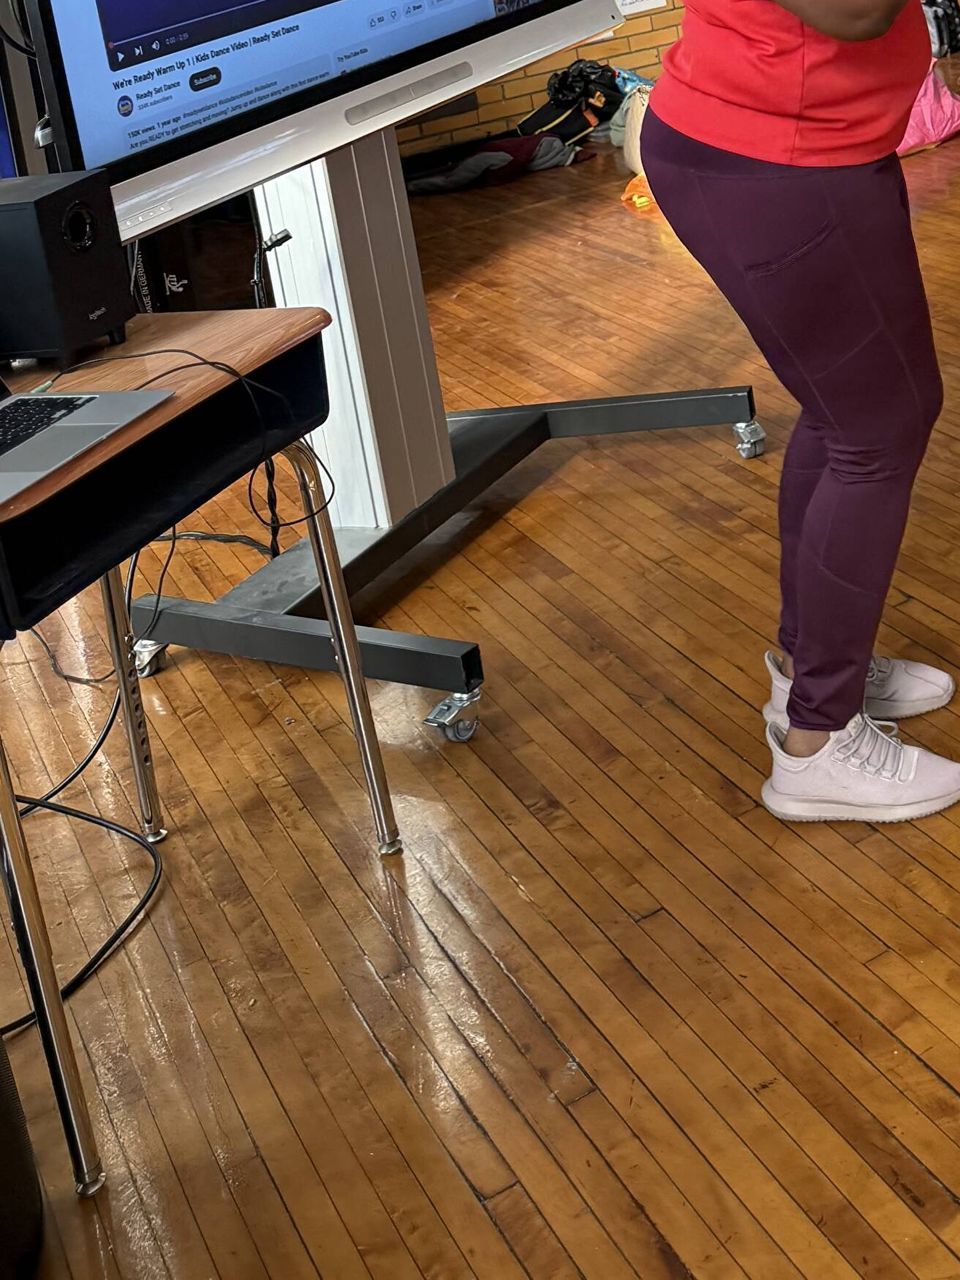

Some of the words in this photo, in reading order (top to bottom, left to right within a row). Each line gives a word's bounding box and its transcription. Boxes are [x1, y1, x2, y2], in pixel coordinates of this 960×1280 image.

[112, 78, 133, 90] We're
[133, 71, 155, 84] Ready
[155, 64, 176, 76] Warm
[175, 61, 186, 70] Up
[195, 53, 210, 63] Kids
[210, 47, 231, 58] Dance
[230, 40, 249, 52] Video
[252, 33, 271, 44] Ready
[271, 30, 282, 39] Set
[281, 24, 300, 35] Dance
[135, 90, 153, 100] Ready
[153, 87, 163, 95] Set
[163, 81, 181, 91] Dance
